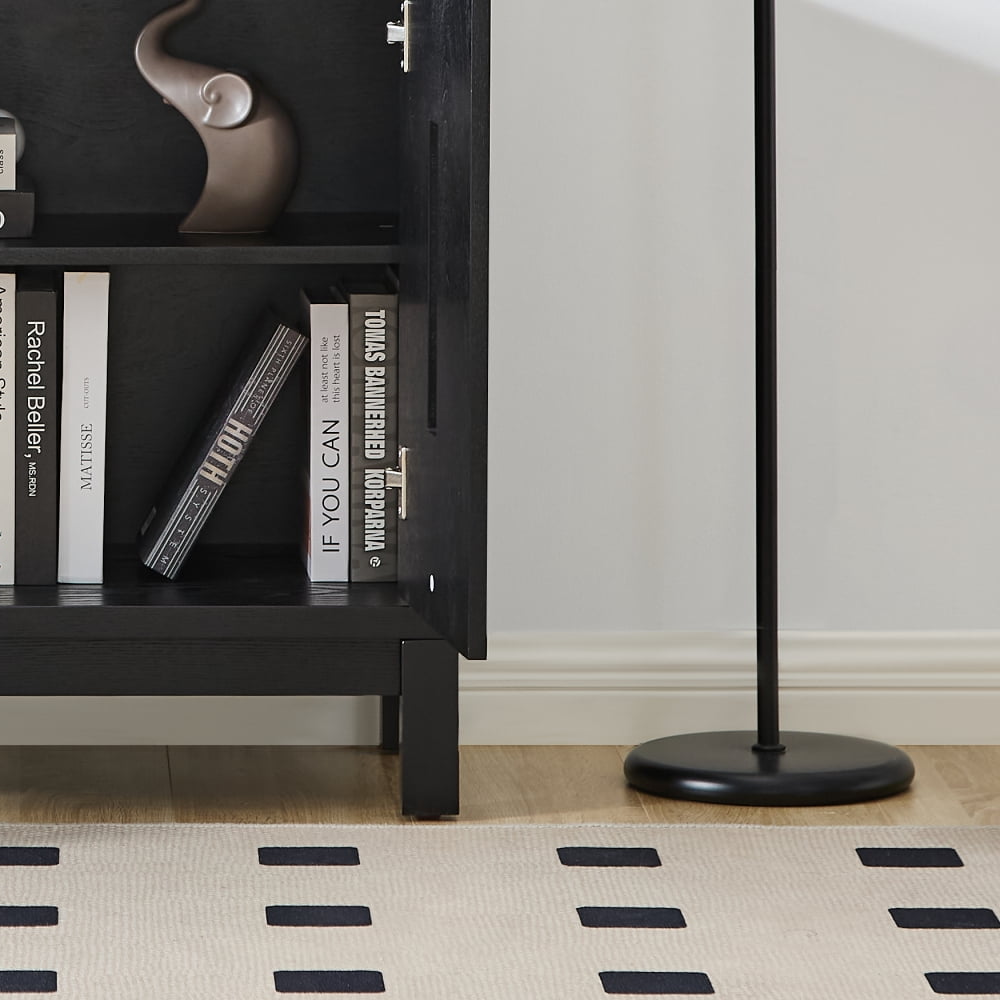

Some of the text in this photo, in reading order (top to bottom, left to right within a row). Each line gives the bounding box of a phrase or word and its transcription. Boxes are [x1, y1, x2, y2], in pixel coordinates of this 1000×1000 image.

[320, 336, 328, 352] like
[332, 335, 341, 403] this heart is lost
[24, 321, 45, 497] Rachel Beller, MS.RDN
[321, 394, 328, 403] at
[364, 309, 386, 551] TOMAS BANNERHED KORPARNA
[80, 423, 92, 490] MATISSE
[200, 418, 252, 486] HOTH
[322, 420, 340, 552] IF YOU CAN
[161, 487, 208, 564] SYSTEM
